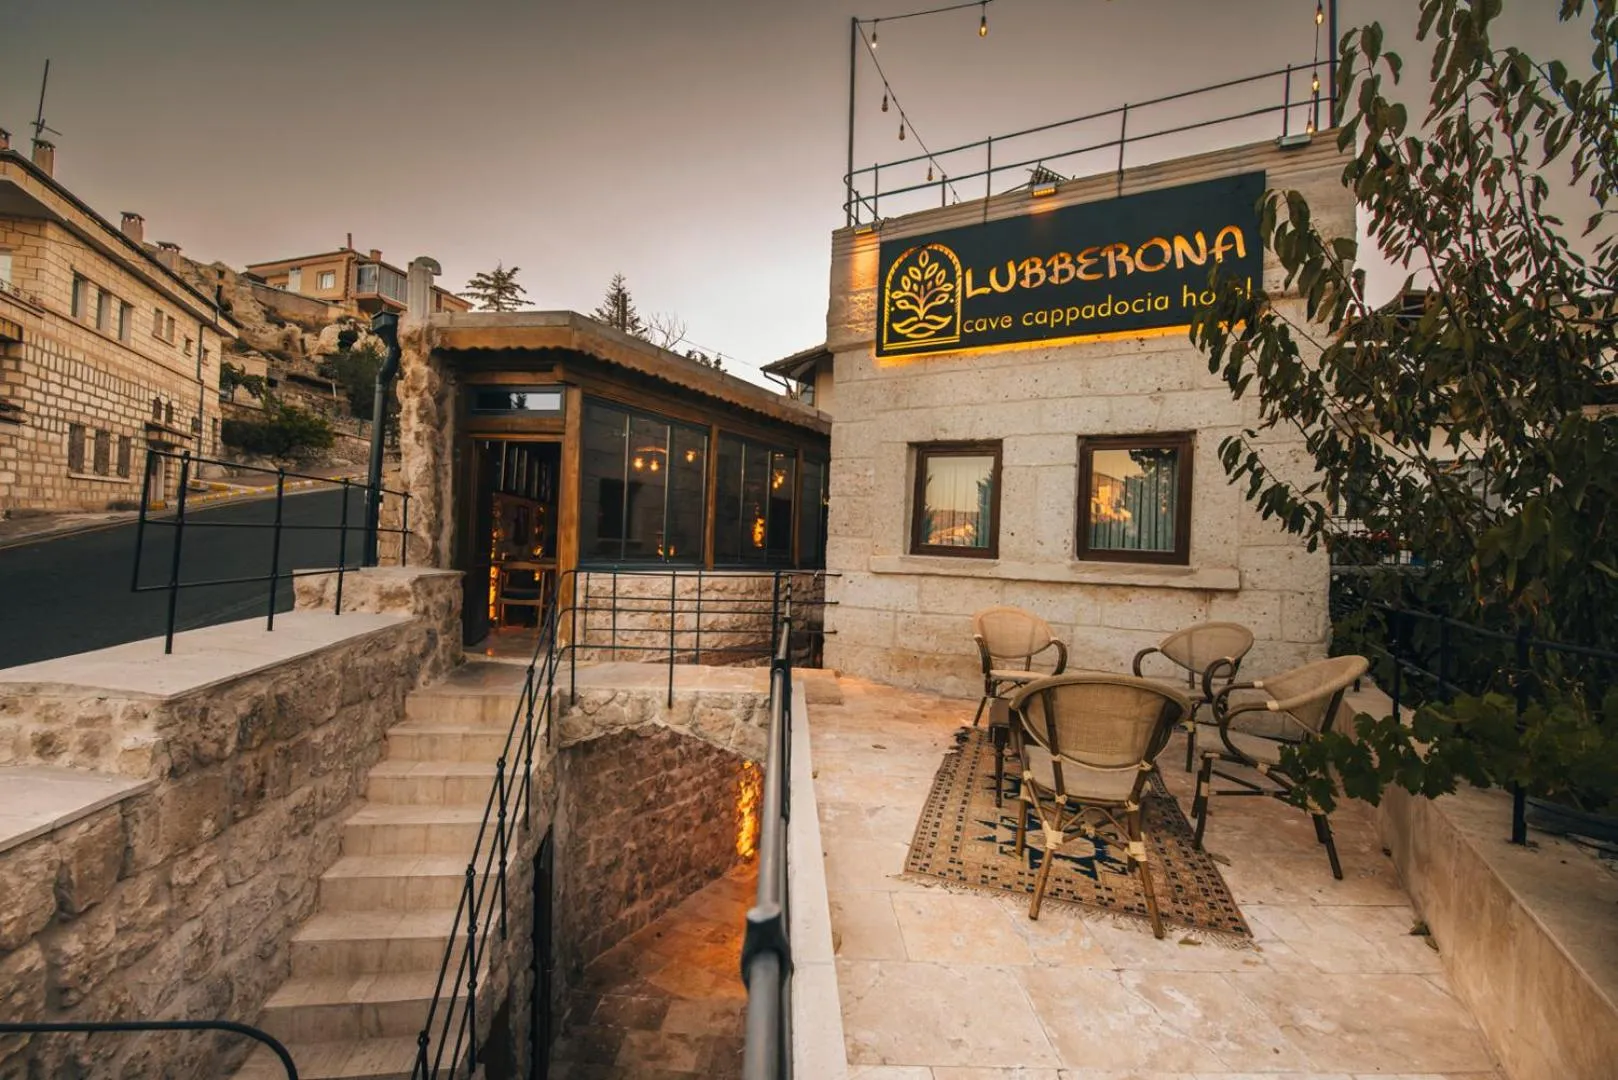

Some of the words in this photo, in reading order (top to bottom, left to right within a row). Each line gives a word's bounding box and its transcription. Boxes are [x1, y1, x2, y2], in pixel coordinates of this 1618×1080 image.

[964, 225, 1247, 299] LUBBERONA
[962, 315, 1012, 334] cave
[1021, 293, 1169, 326] cappadocia
[1182, 276, 1252, 308] hol
